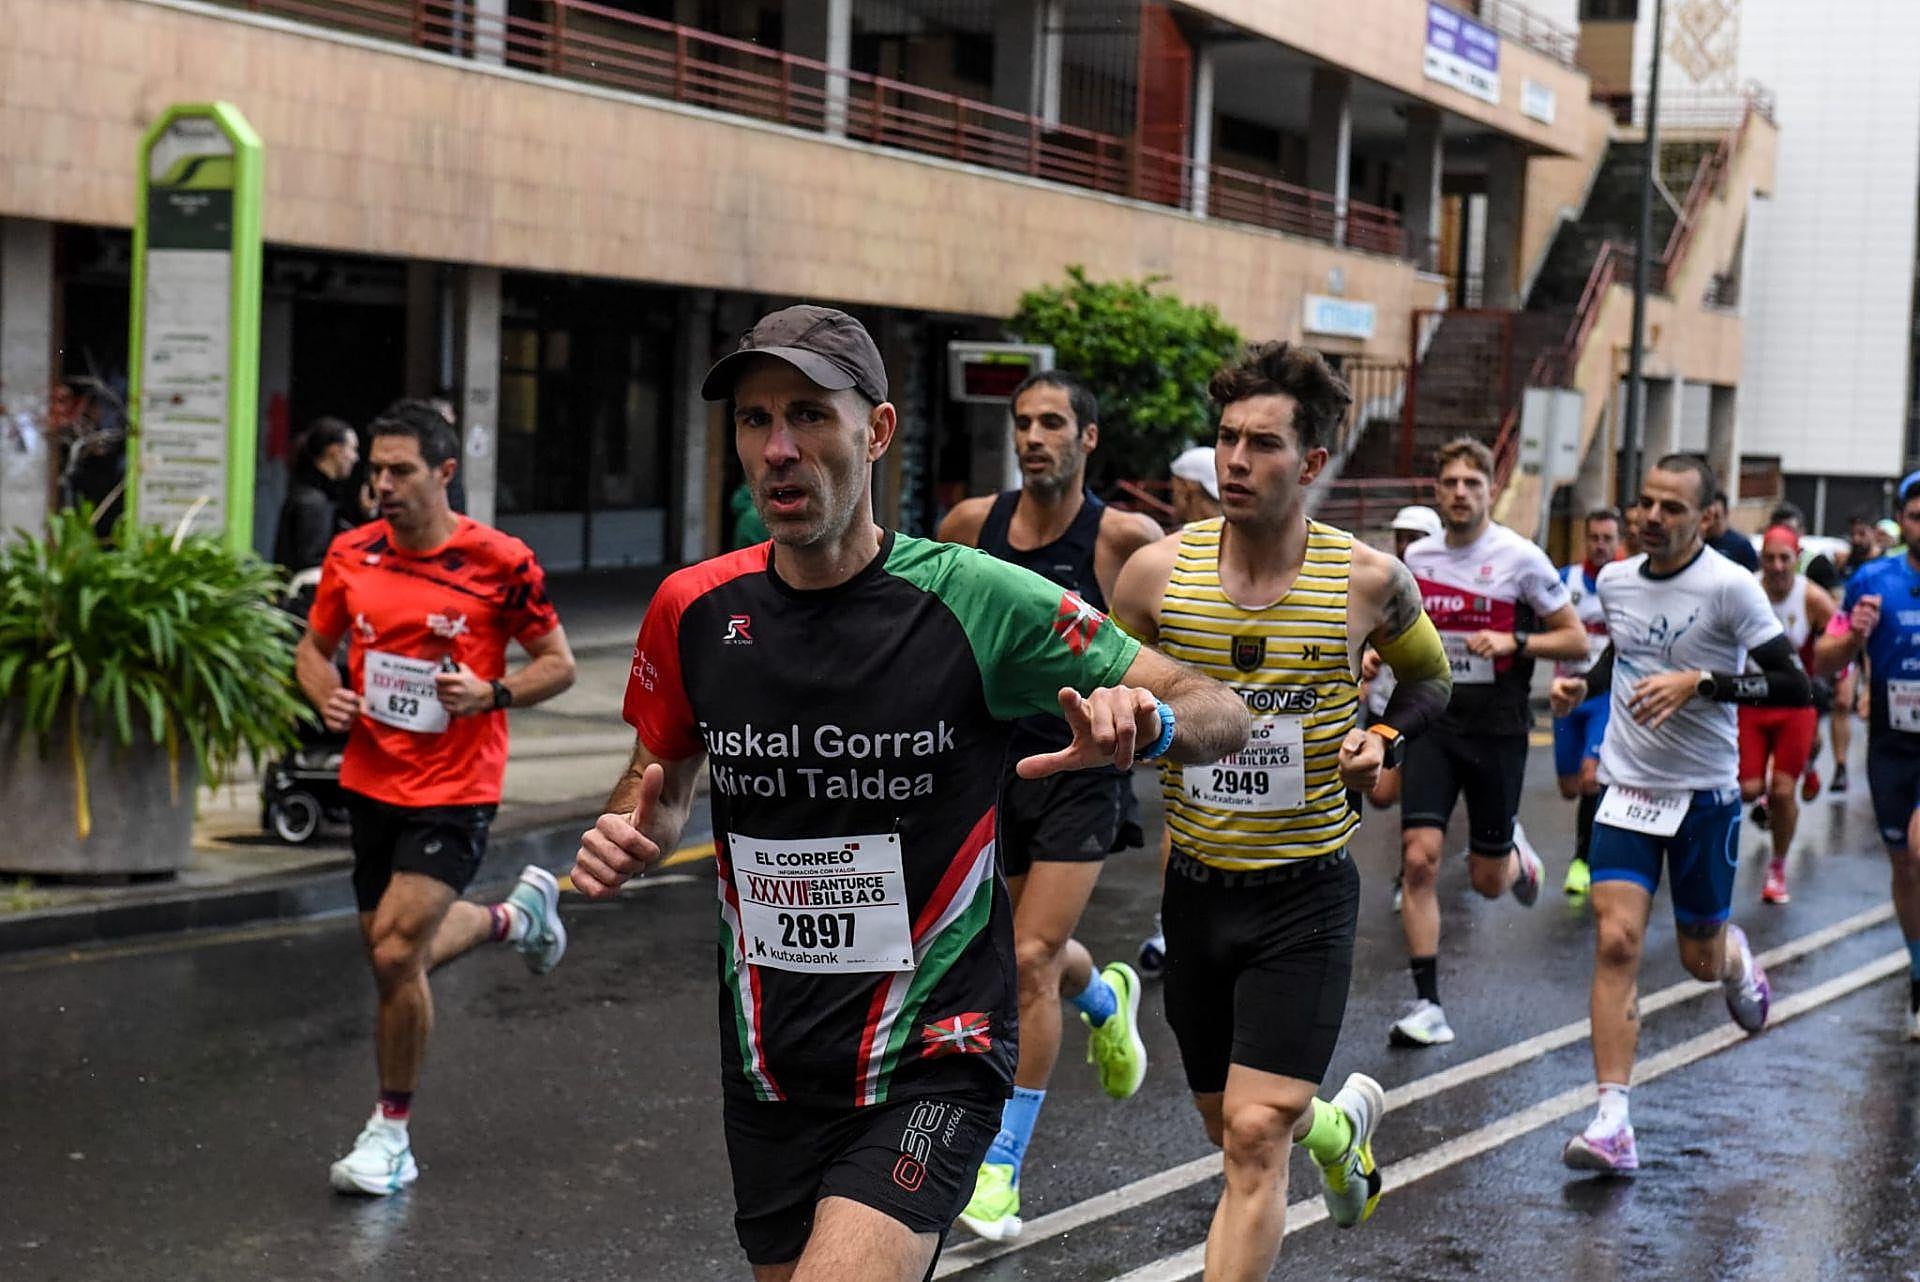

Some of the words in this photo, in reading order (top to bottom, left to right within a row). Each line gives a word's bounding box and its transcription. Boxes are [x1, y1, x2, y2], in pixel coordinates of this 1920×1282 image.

[1238, 689, 1316, 711] TONES
[813, 720, 955, 759] Gorrak
[1240, 746, 1289, 756] ANTURCE
[1239, 755, 1290, 766] BILBAO
[712, 764, 787, 798] Kirol
[796, 768, 933, 800] Taldea
[1212, 768, 1270, 796] 2949
[755, 851, 775, 866] EL
[776, 850, 854, 867] CORREO
[819, 867, 834, 875] CON
[810, 876, 884, 892] SANTURCE
[811, 888, 885, 906] BILBAO
[778, 911, 856, 949] 2897
[769, 947, 839, 964] kutxabank
